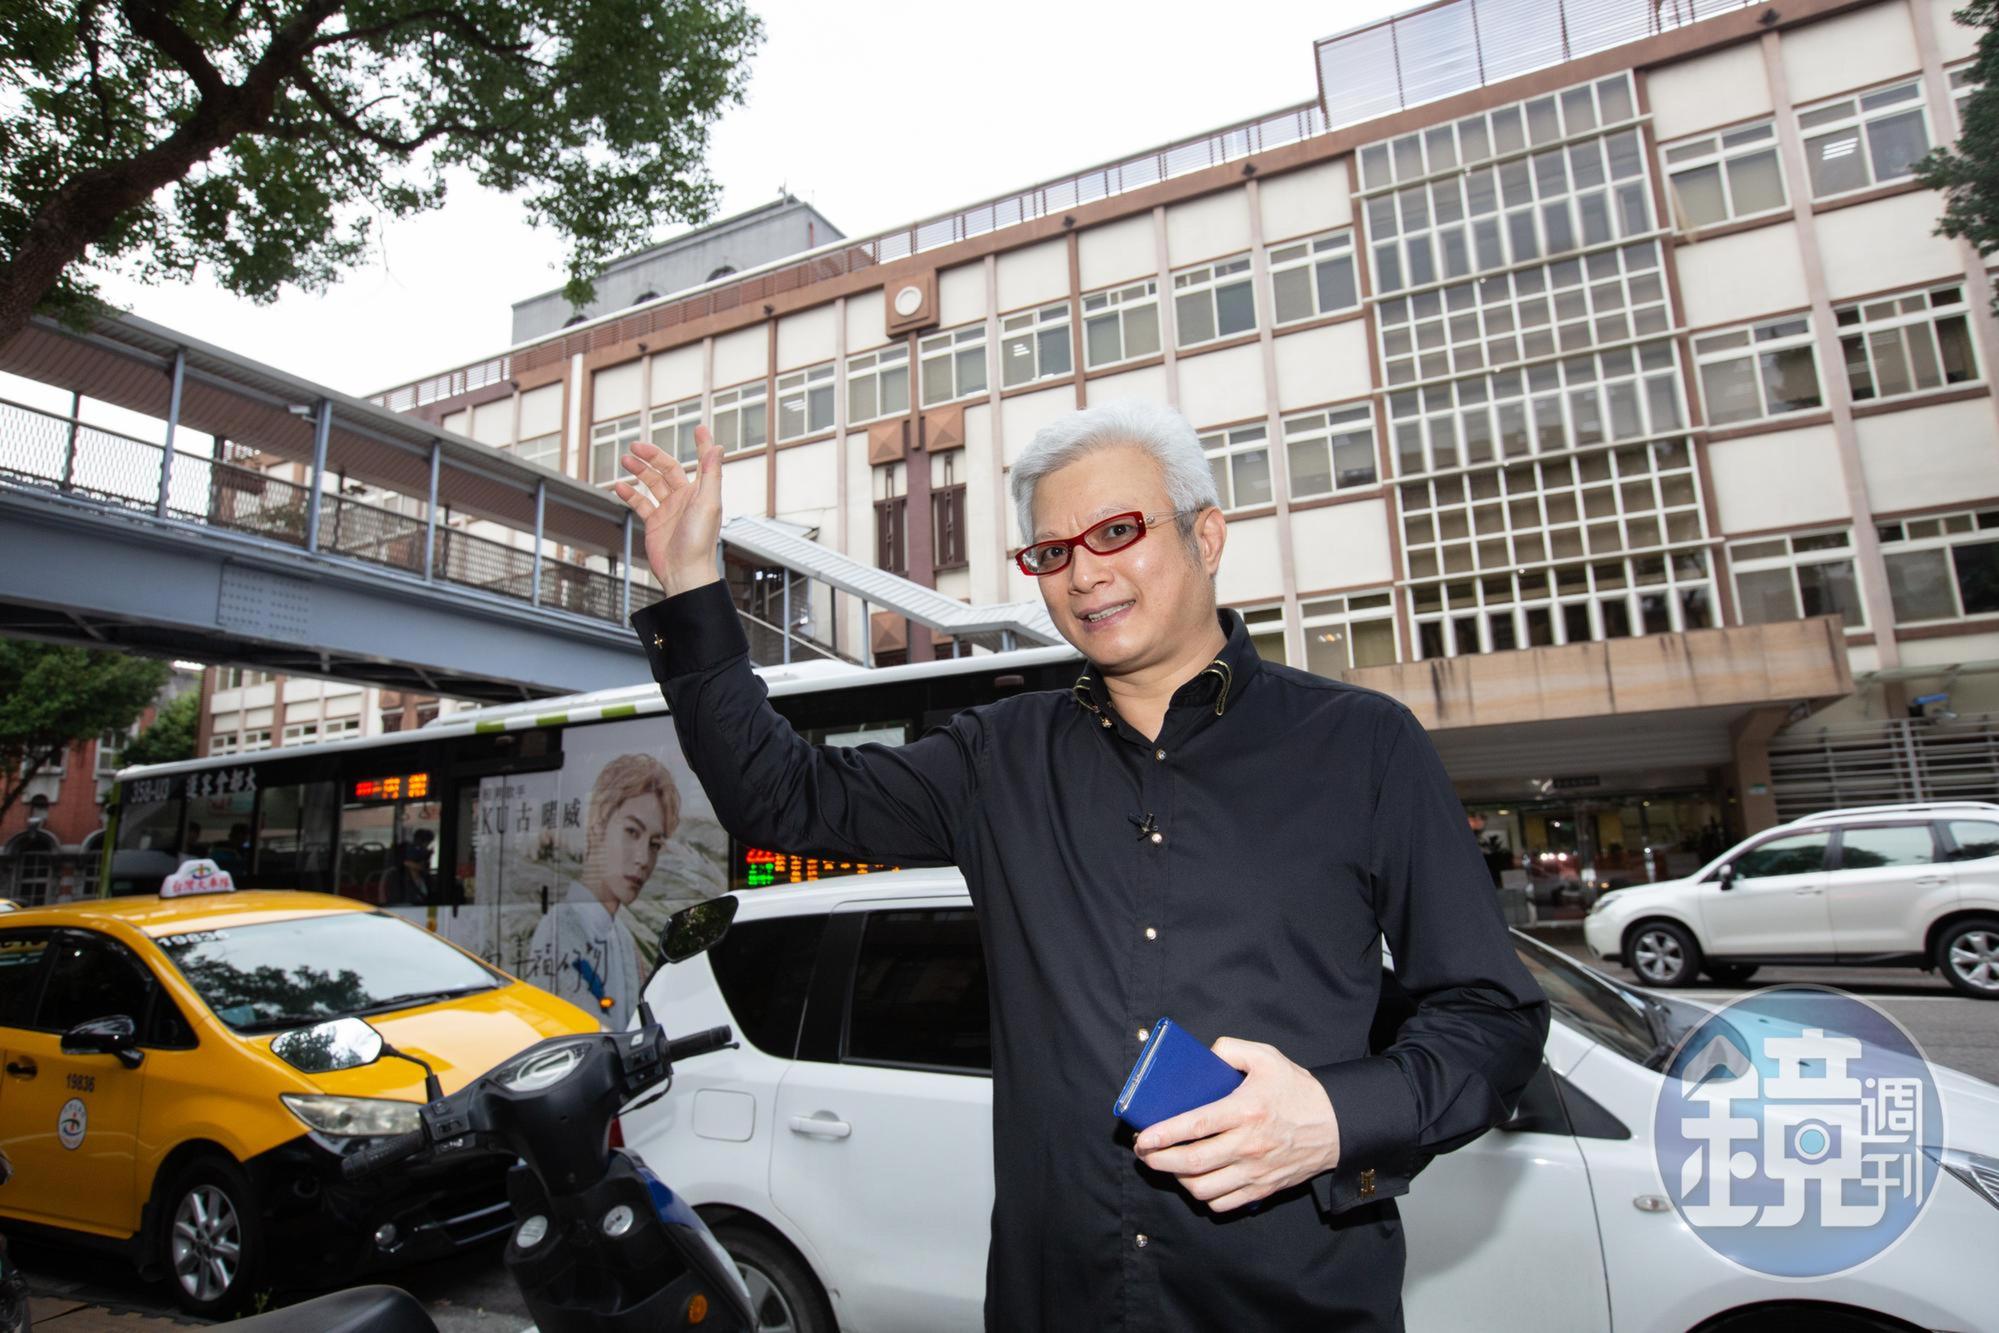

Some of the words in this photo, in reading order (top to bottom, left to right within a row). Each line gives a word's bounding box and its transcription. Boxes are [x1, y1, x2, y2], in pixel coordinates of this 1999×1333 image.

[481, 806, 509, 835] KU
[172, 877, 229, 893] 台灣大車隊
[66, 1072, 96, 1093] 19836
